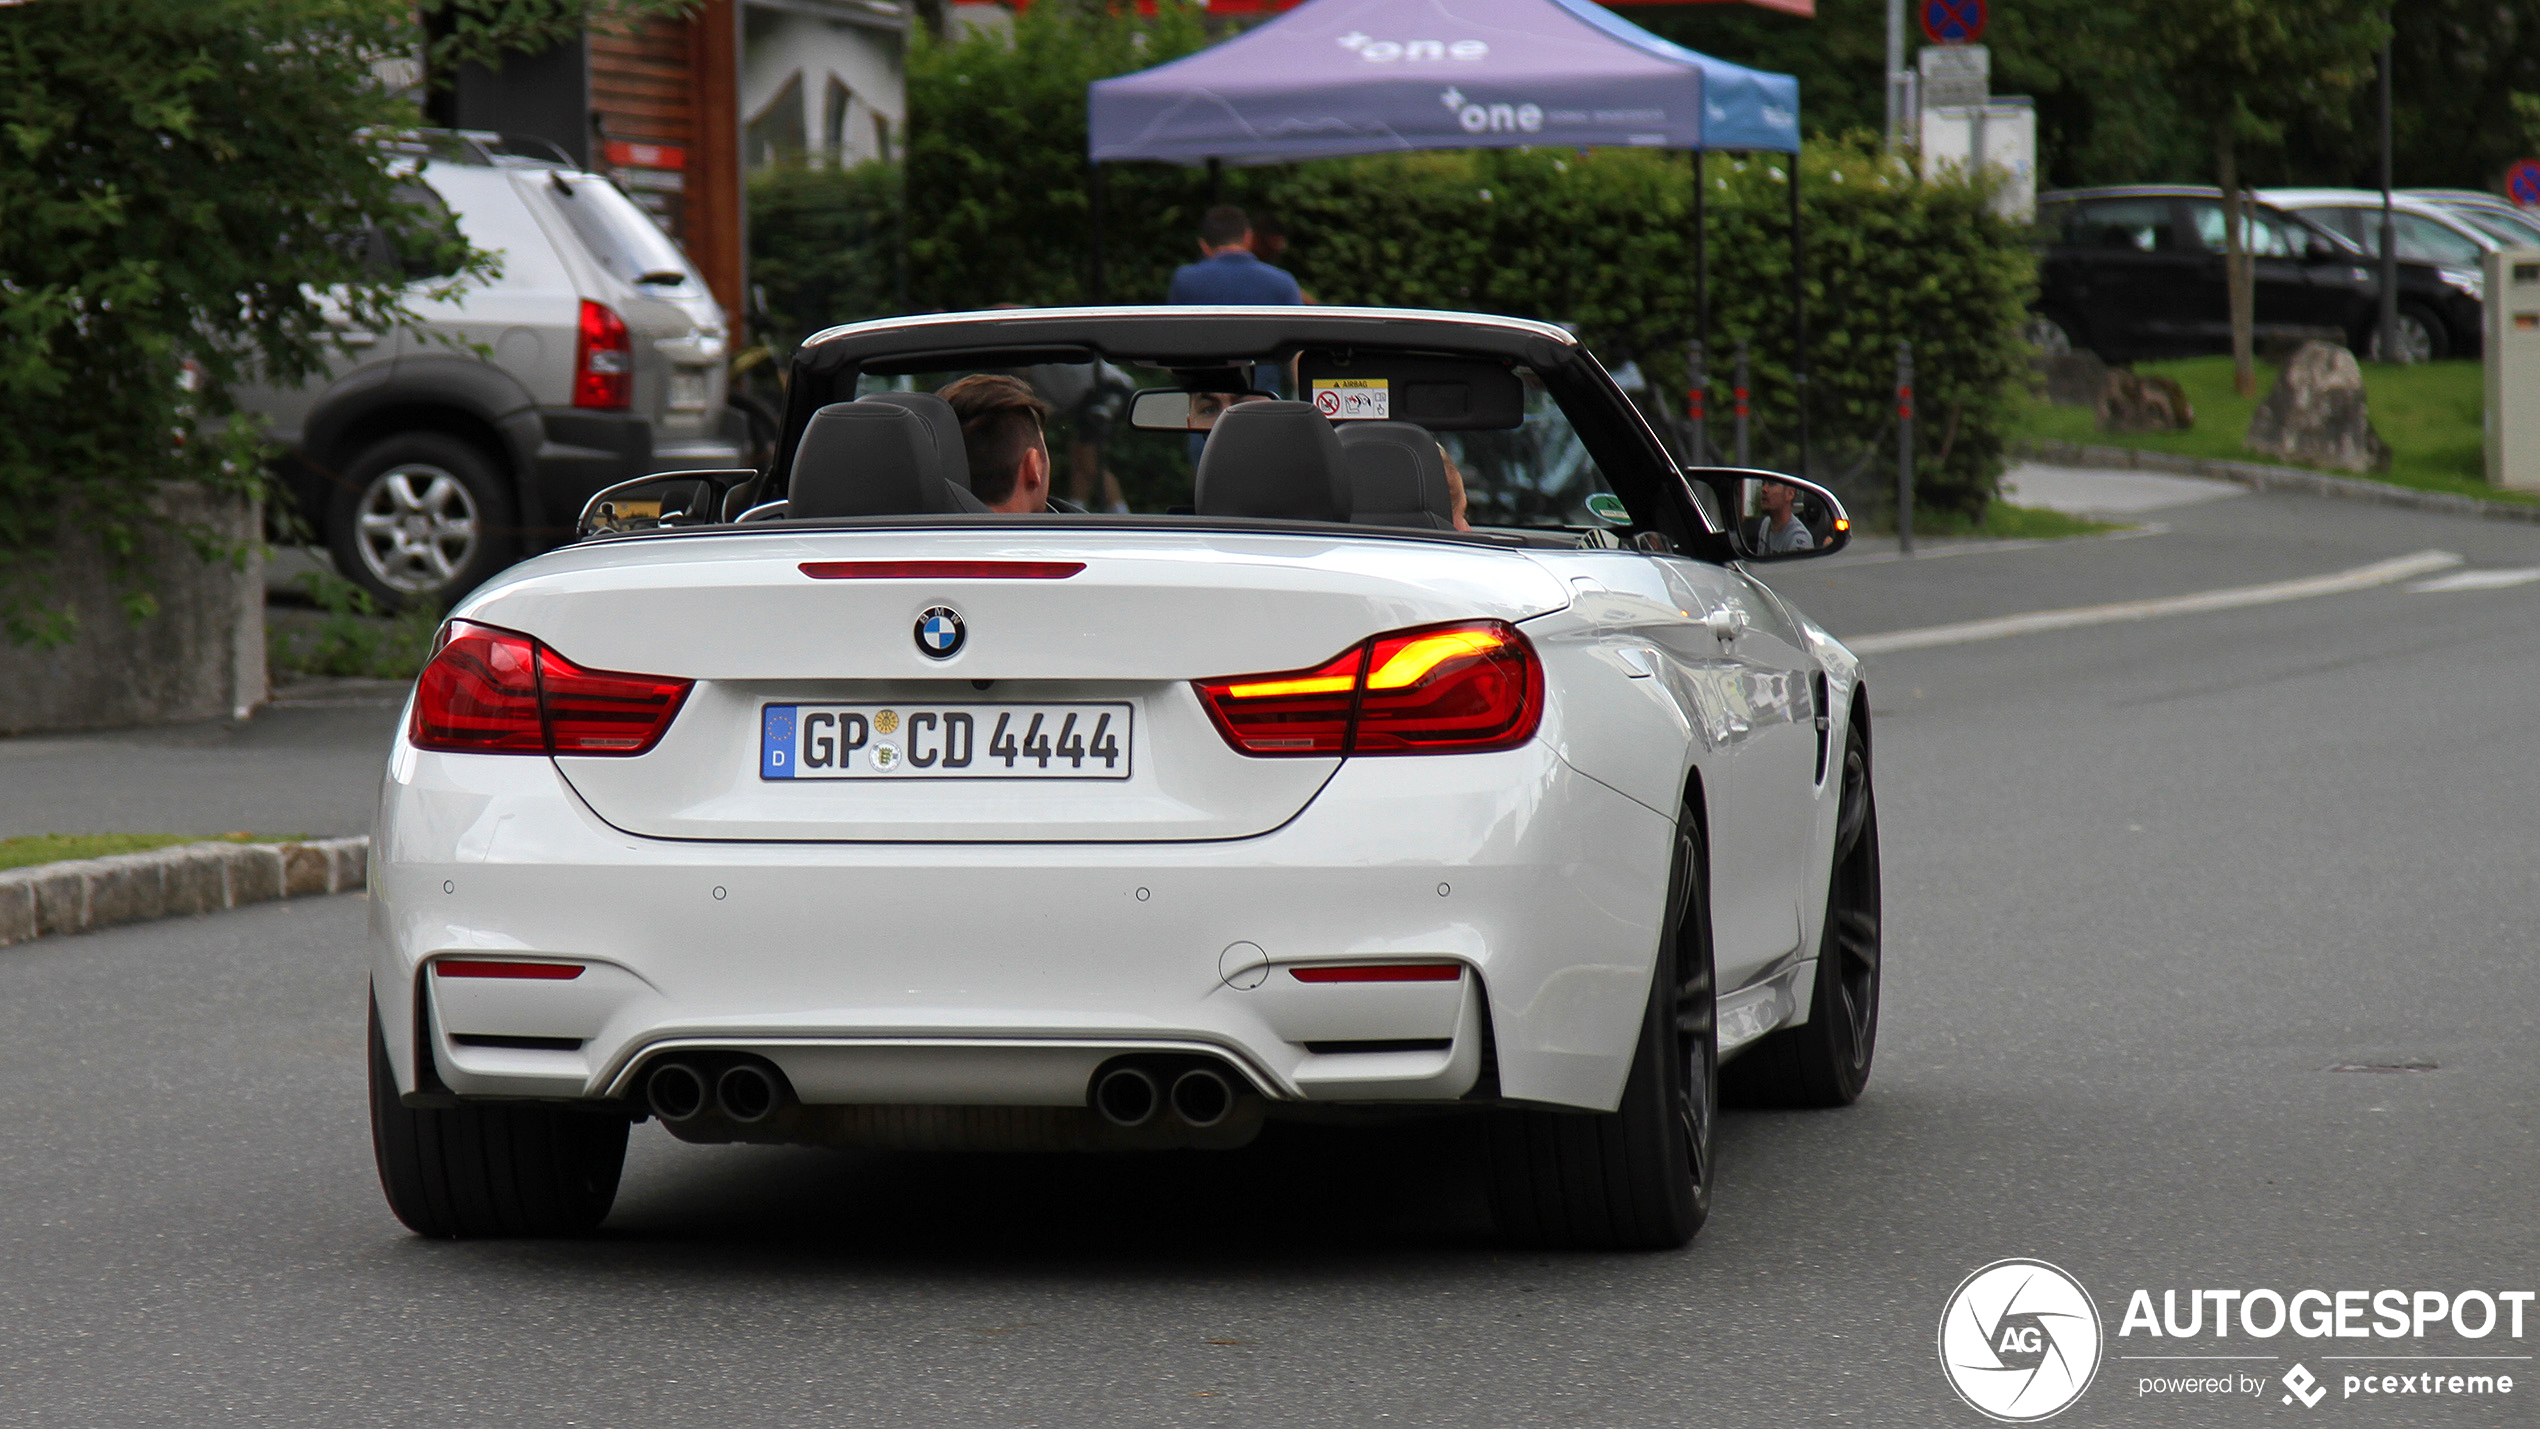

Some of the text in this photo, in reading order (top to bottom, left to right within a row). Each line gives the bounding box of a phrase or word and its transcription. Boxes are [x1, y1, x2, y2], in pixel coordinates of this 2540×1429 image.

[919, 607, 961, 625] BMW
[803, 712, 1119, 769] GP CD 4444
[772, 750, 785, 767] D
